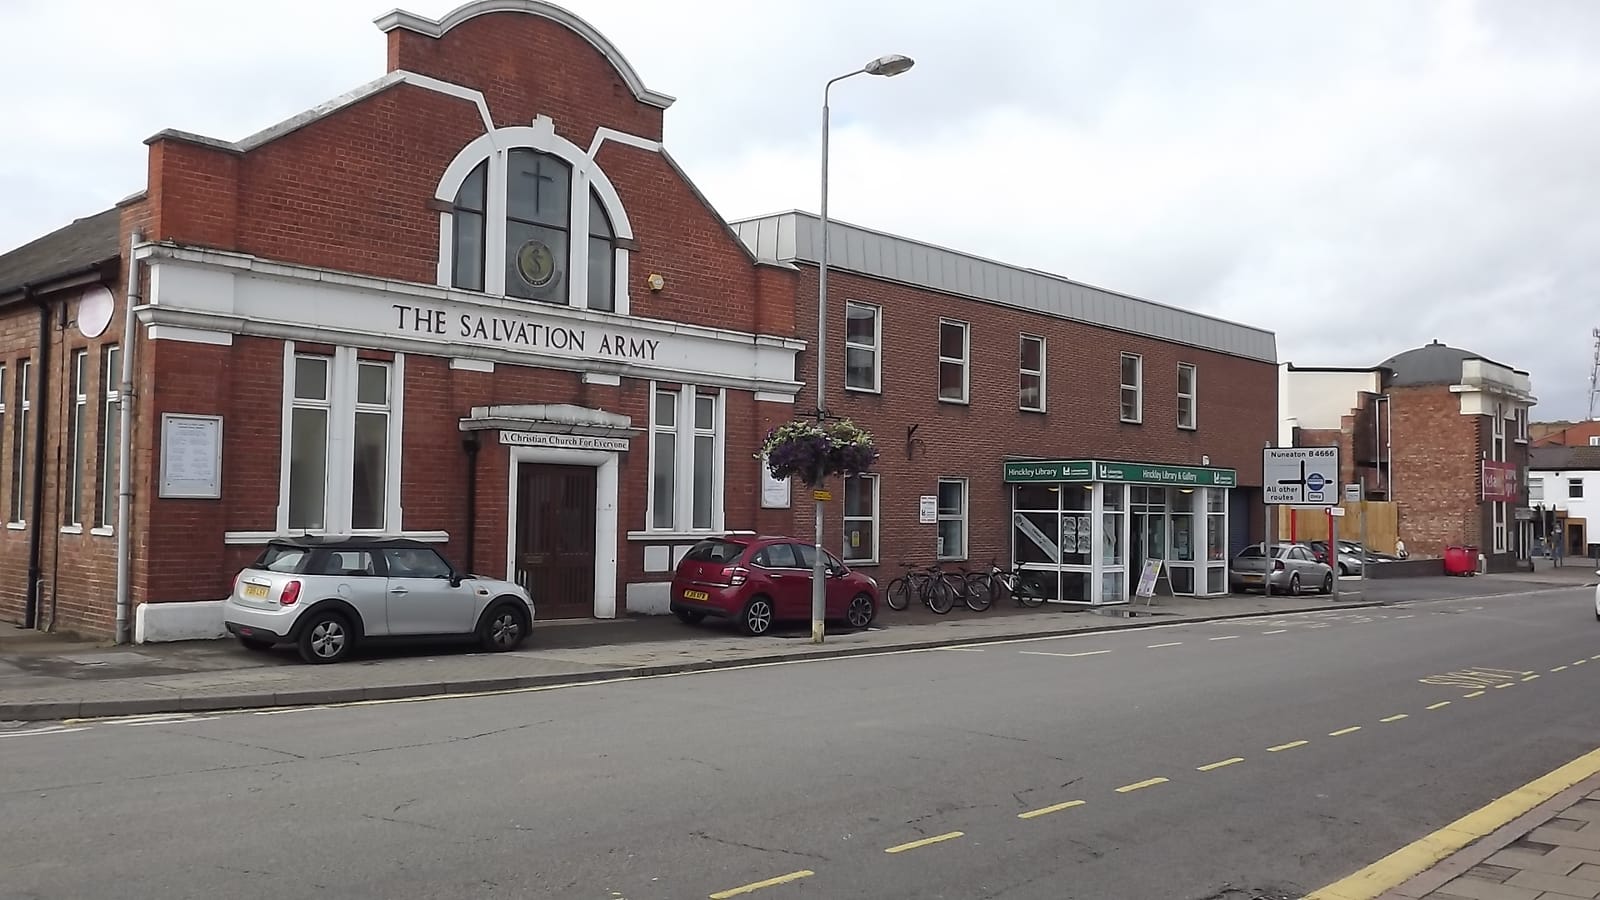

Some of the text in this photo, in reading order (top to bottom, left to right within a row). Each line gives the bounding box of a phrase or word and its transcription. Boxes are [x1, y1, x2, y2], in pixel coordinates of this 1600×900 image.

[392, 304, 660, 361] THE SALVATION ARMY
[501, 432, 627, 449] A Christian Church For Everyone
[1008, 467, 1057, 477] Hinckley Library
[1142, 469, 1161, 481] Hinckley
[1162, 470, 1177, 482] Library
